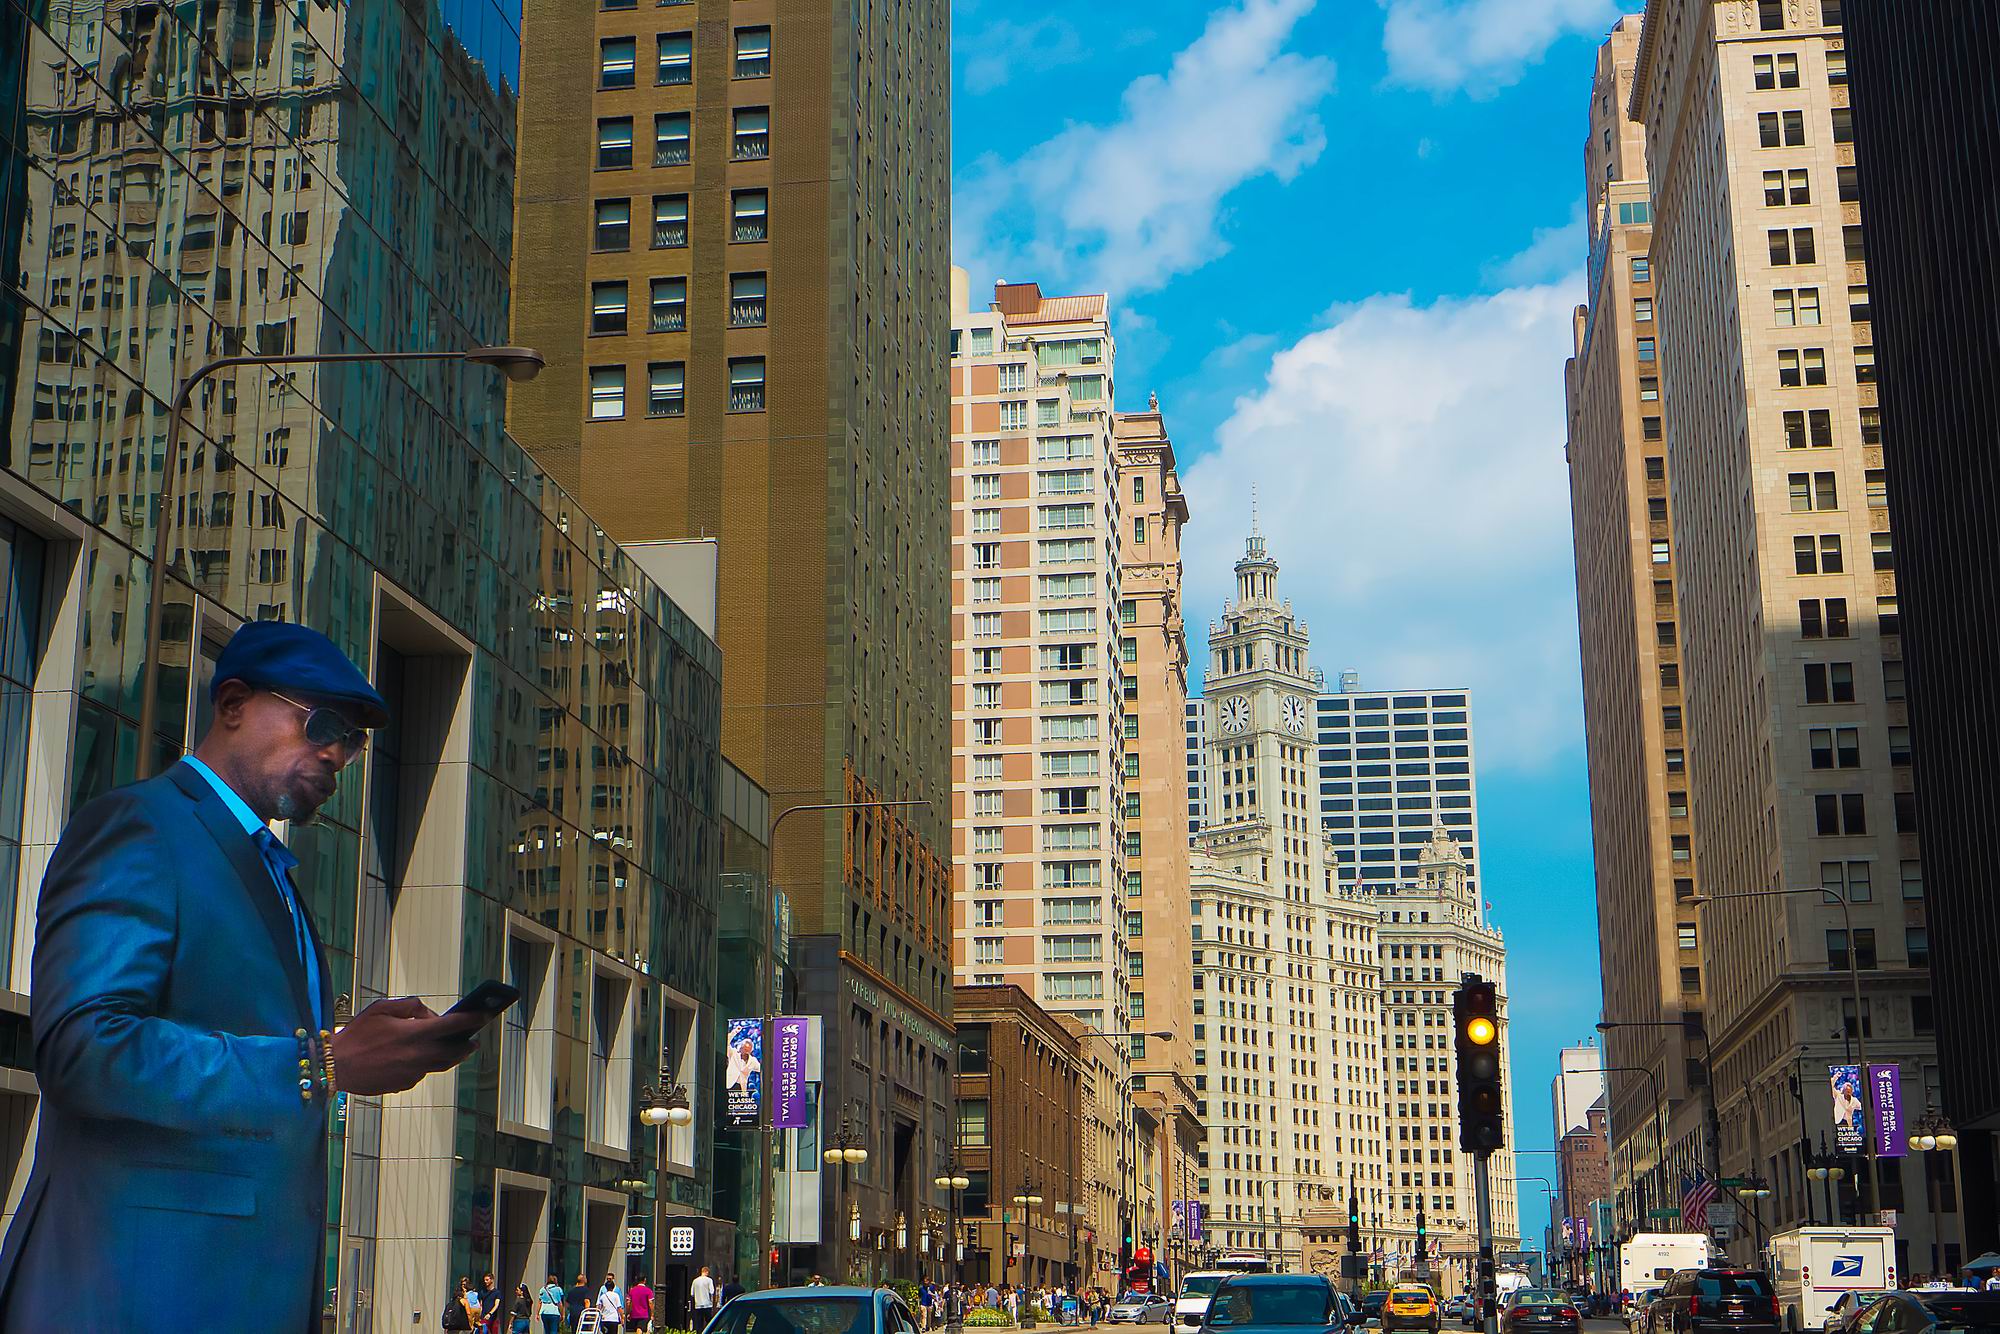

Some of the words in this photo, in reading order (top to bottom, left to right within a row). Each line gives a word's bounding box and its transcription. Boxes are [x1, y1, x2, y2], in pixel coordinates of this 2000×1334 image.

[790, 1037, 798, 1069] GRANT
[1879, 1081, 1887, 1108] MUSIC
[1886, 1081, 1894, 1109] GRANT
[1882, 1111, 1891, 1152] FESTIVAL
